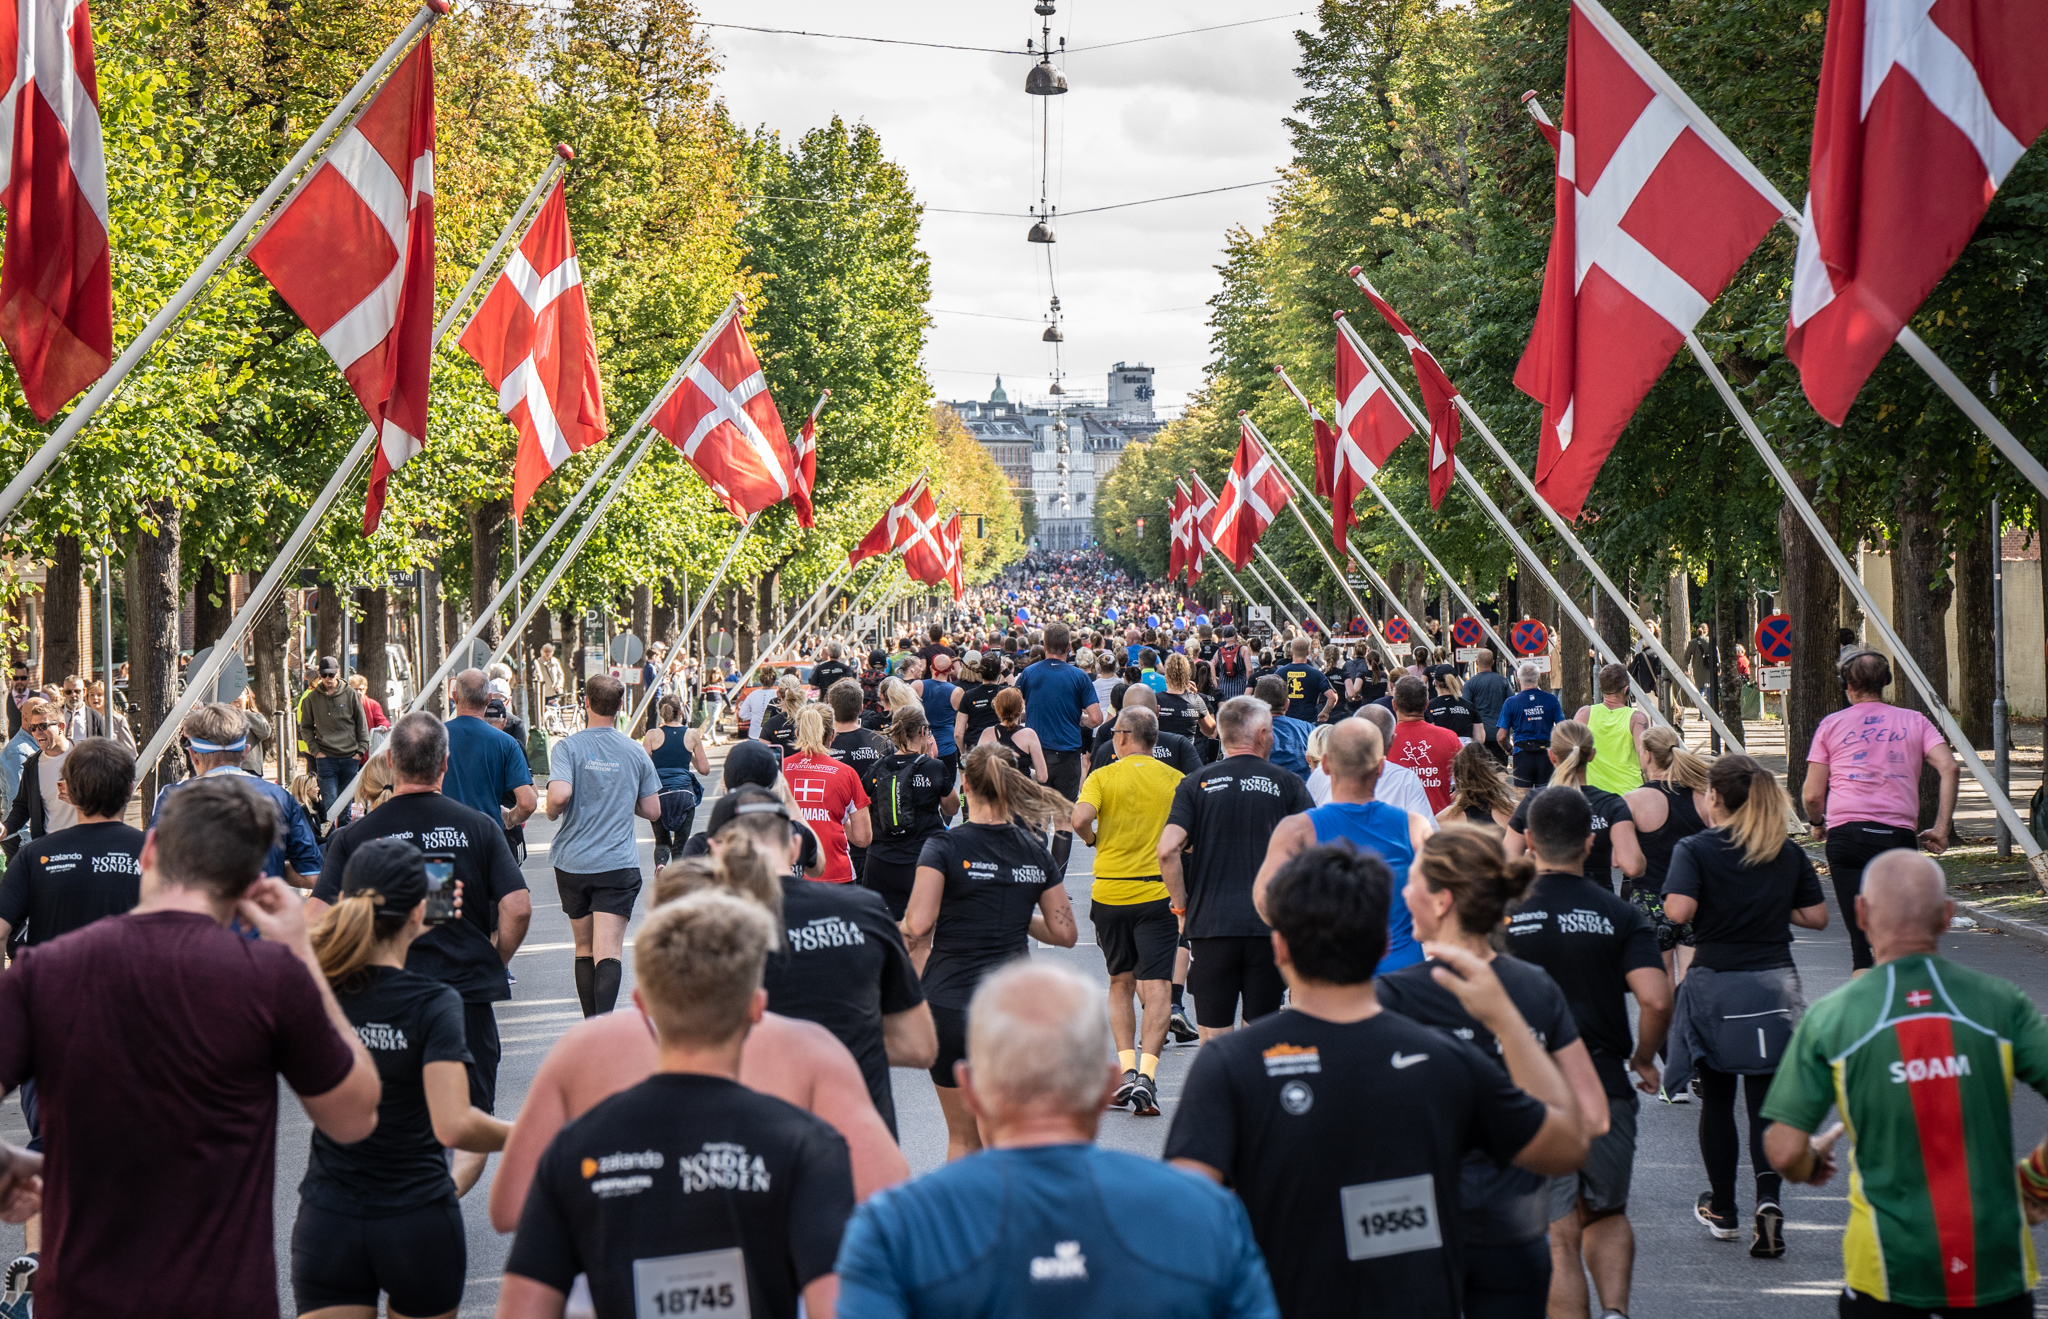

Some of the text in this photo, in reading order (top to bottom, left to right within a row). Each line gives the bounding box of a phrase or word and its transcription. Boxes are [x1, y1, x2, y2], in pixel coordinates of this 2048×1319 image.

[586, 609, 598, 628] P
[1254, 609, 1261, 619] 9
[234, 669, 243, 688] PFL
[1843, 727, 1908, 745] CREW
[1240, 778, 1279, 790] NORDEA
[1420, 778, 1442, 787] klub
[1241, 784, 1281, 797] FONDEN
[801, 808, 831, 821] MARK
[389, 831, 414, 840] lando
[421, 831, 467, 842] NORDEA
[424, 838, 469, 849] FONDEN
[49, 852, 82, 862] zalando
[91, 856, 141, 868] NORDEA
[93, 863, 142, 876] FONDEN
[971, 861, 999, 871] zalando
[1011, 868, 1046, 877] NORDEA
[1014, 875, 1047, 883] FONDEN
[1511, 910, 1548, 923] zalando
[1557, 913, 1611, 926] NORDEA
[787, 921, 860, 942] NORDEA
[1561, 923, 1615, 936] FONDEN
[794, 931, 865, 952] FONDEN
[362, 1037, 408, 1050] ONDEN
[1888, 1054, 1972, 1084] SØAM
[678, 1151, 766, 1176] NORDEA
[682, 1170, 772, 1194] FONDEN
[1358, 1205, 1429, 1238] 19563
[652, 1283, 734, 1316] 18745
